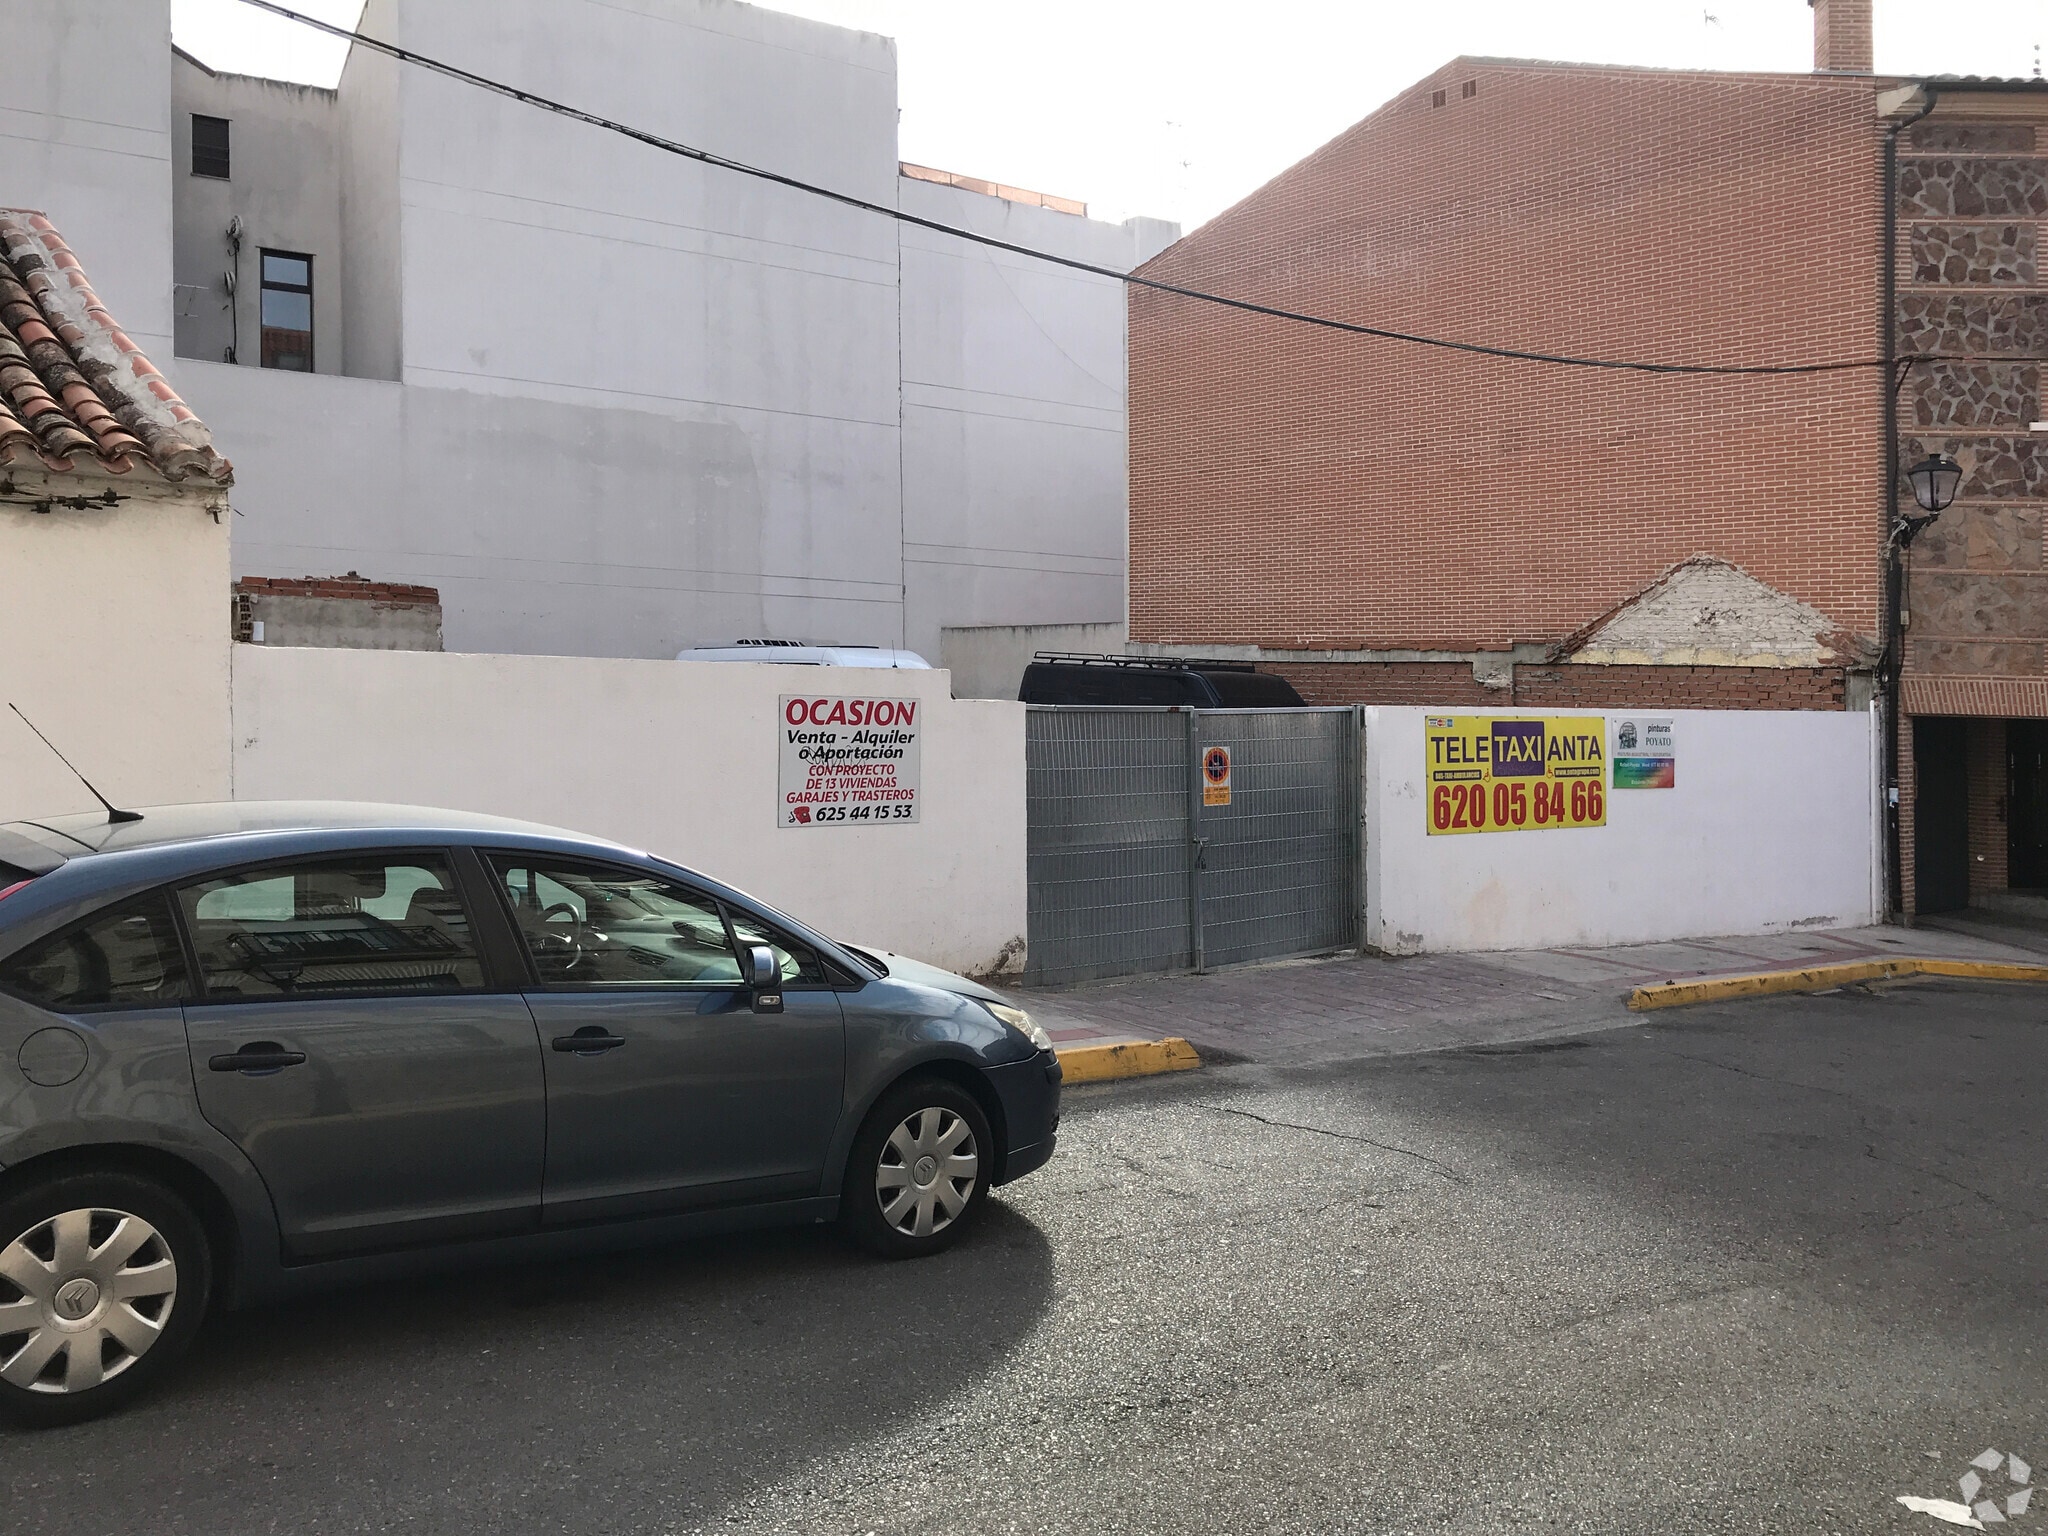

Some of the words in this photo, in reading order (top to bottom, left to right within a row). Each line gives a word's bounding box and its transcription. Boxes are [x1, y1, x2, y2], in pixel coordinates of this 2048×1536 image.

[785, 698, 917, 727] OCASION
[1647, 723, 1672, 734] pinturas
[787, 729, 837, 744] Venta
[850, 729, 916, 747] Alquiler
[1645, 737, 1672, 747] POYATO
[798, 747, 809, 760] o
[812, 744, 904, 762] Aportación
[1430, 736, 1490, 764] TELE
[1493, 735, 1543, 763] TAXI
[1546, 735, 1603, 762] ANTA
[808, 764, 833, 777] CON
[835, 763, 896, 777] PROYECTO
[805, 777, 823, 790] DE
[825, 777, 837, 790] 13
[839, 776, 898, 790] VIVIENDAS
[786, 790, 840, 804] GARAJES
[842, 790, 850, 803] Y
[852, 788, 915, 803] TRASTEROS
[1433, 784, 1486, 830] 620
[1493, 782, 1527, 827] 05
[1533, 781, 1566, 825] 84
[1571, 780, 1603, 823] 66
[816, 806, 847, 822] 625
[849, 805, 871, 820] 44
[874, 804, 890, 820] 15
[893, 804, 913, 819] 53
